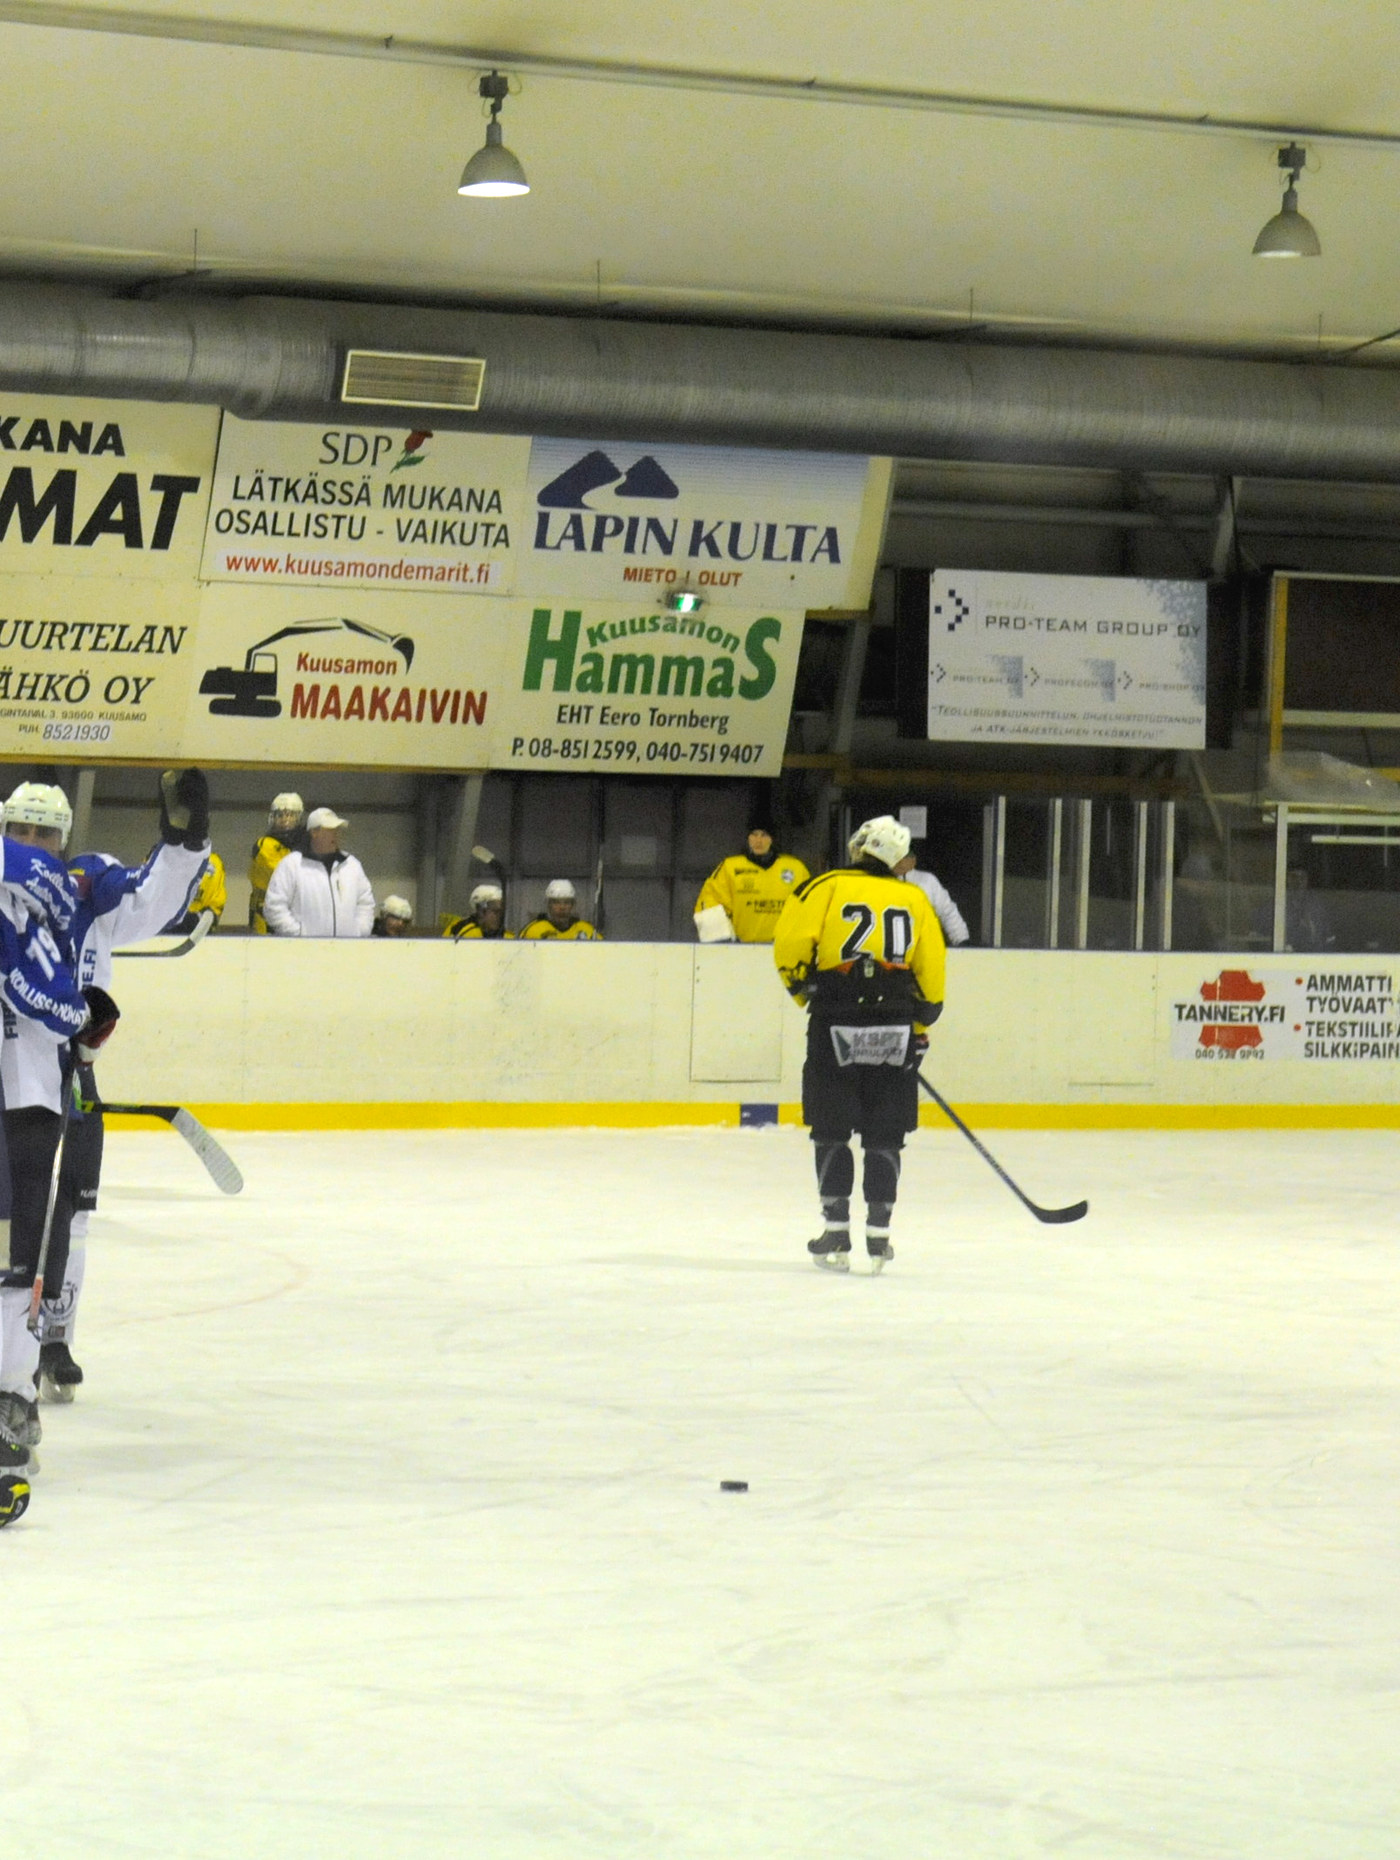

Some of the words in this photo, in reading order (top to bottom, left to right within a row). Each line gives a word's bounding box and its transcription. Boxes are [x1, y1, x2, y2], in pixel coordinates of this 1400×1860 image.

[318, 430, 393, 467] SDP
[232, 468, 372, 507] LÄTKÄSSÄ
[382, 482, 503, 514] MUKANA
[214, 508, 367, 541] OSALLISTU
[395, 516, 511, 549] VAIKUTA
[533, 510, 679, 556] LAPIN
[687, 519, 842, 565] KULTA
[225, 553, 491, 585] www.kuusamondemarit.fi
[622, 566, 677, 584] MIETO
[698, 570, 743, 587] OLUT
[585, 612, 741, 654] Kuusamon
[1096, 620, 1168, 637] GROUP
[1176, 623, 1202, 638] OY
[296, 651, 398, 676] Kuusamon
[522, 608, 782, 701] HammaS
[103, 675, 156, 705] OY
[290, 683, 488, 726] MAAKAIVIN
[42, 723, 111, 741] 8521930
[98, 712, 147, 722] KUUSAMO
[556, 704, 593, 725] EHT
[599, 706, 641, 727] Eero
[648, 707, 730, 736] Tornberg
[511, 737, 523, 757] P.
[840, 904, 915, 963] 20
[1306, 974, 1392, 992] AMMATTI
[1174, 1003, 1286, 1024] TANNERY.FI
